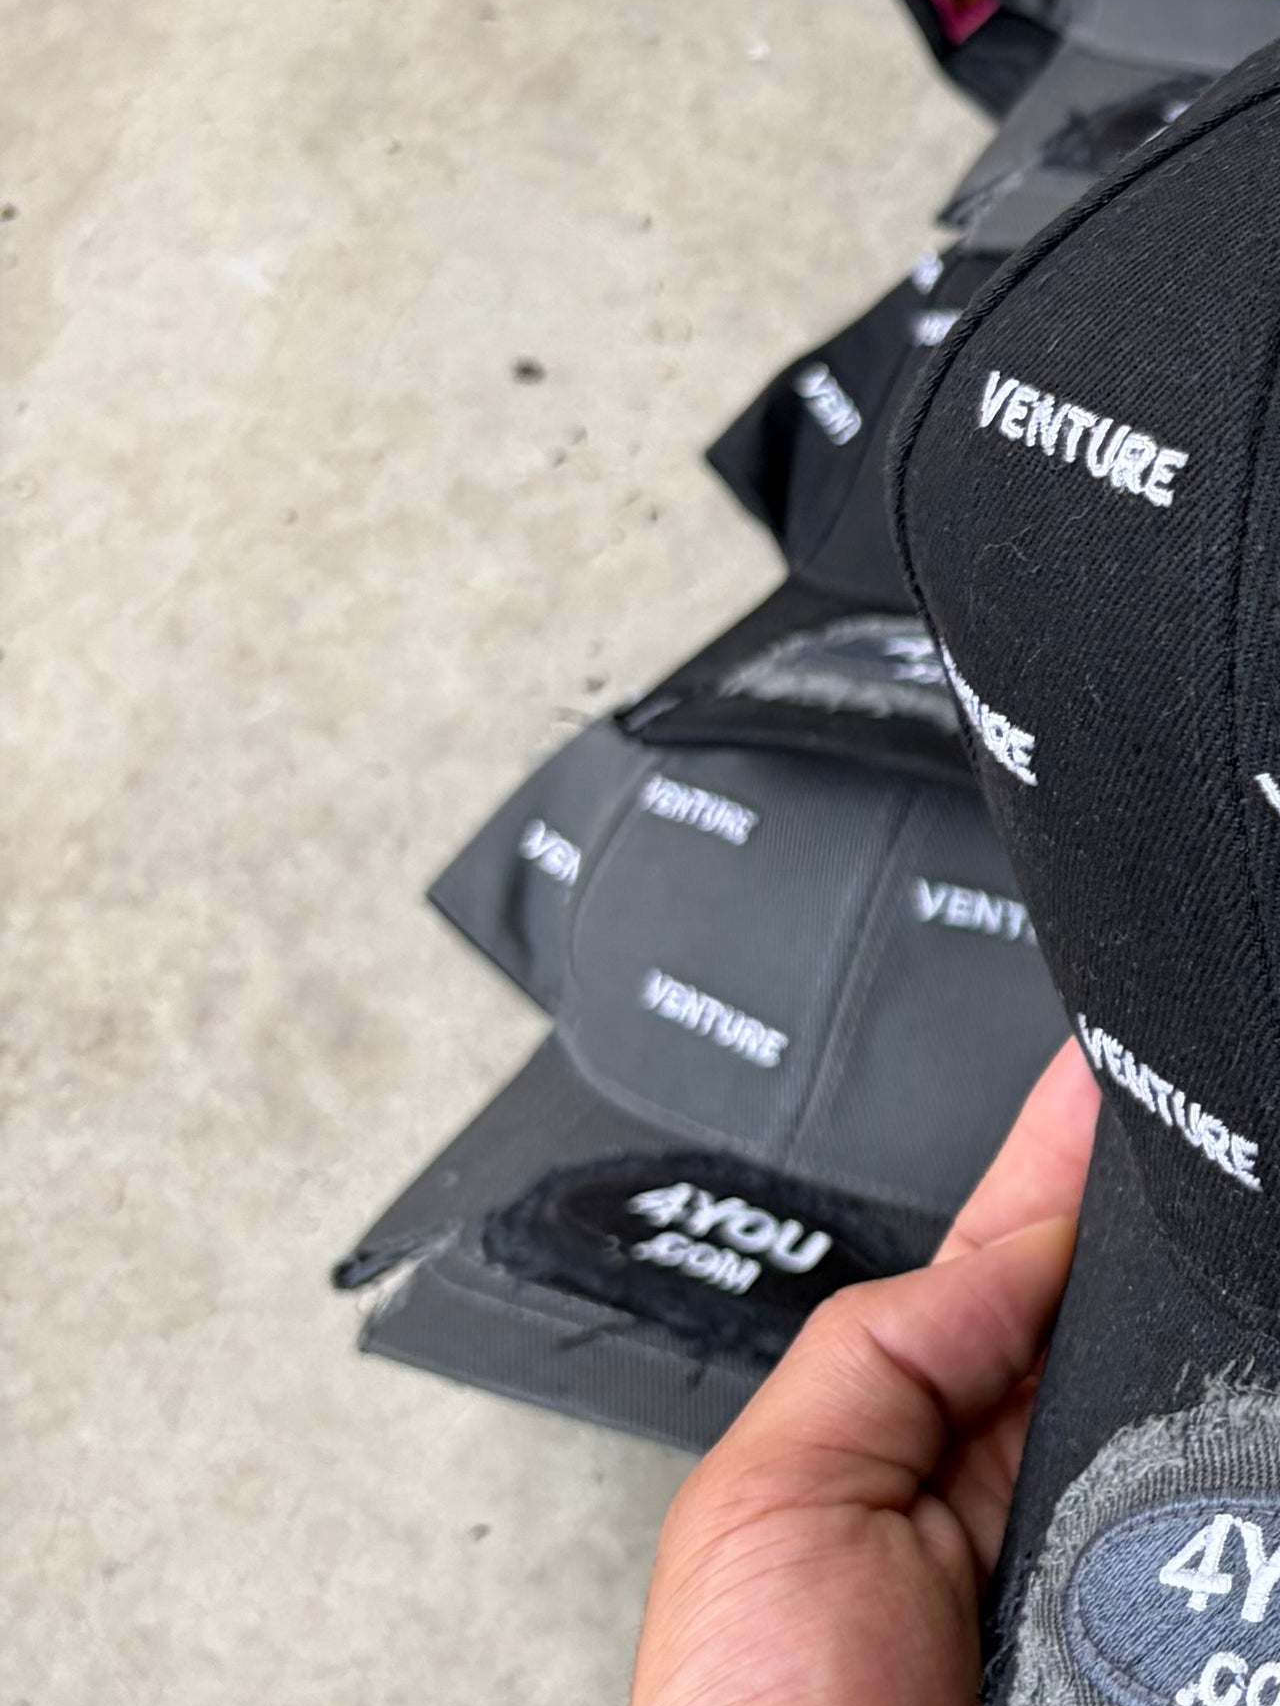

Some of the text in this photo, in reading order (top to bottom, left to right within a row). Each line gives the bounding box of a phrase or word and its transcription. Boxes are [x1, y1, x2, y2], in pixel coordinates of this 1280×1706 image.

[978, 370, 1190, 508] VENTURE
[642, 773, 758, 845] VENTURE
[913, 876, 1037, 946] VENT
[642, 967, 789, 1068] VENTURE
[1077, 1012, 1263, 1192] VENTURE
[627, 1181, 832, 1274] 4YOU
[629, 1231, 762, 1294] .COM
